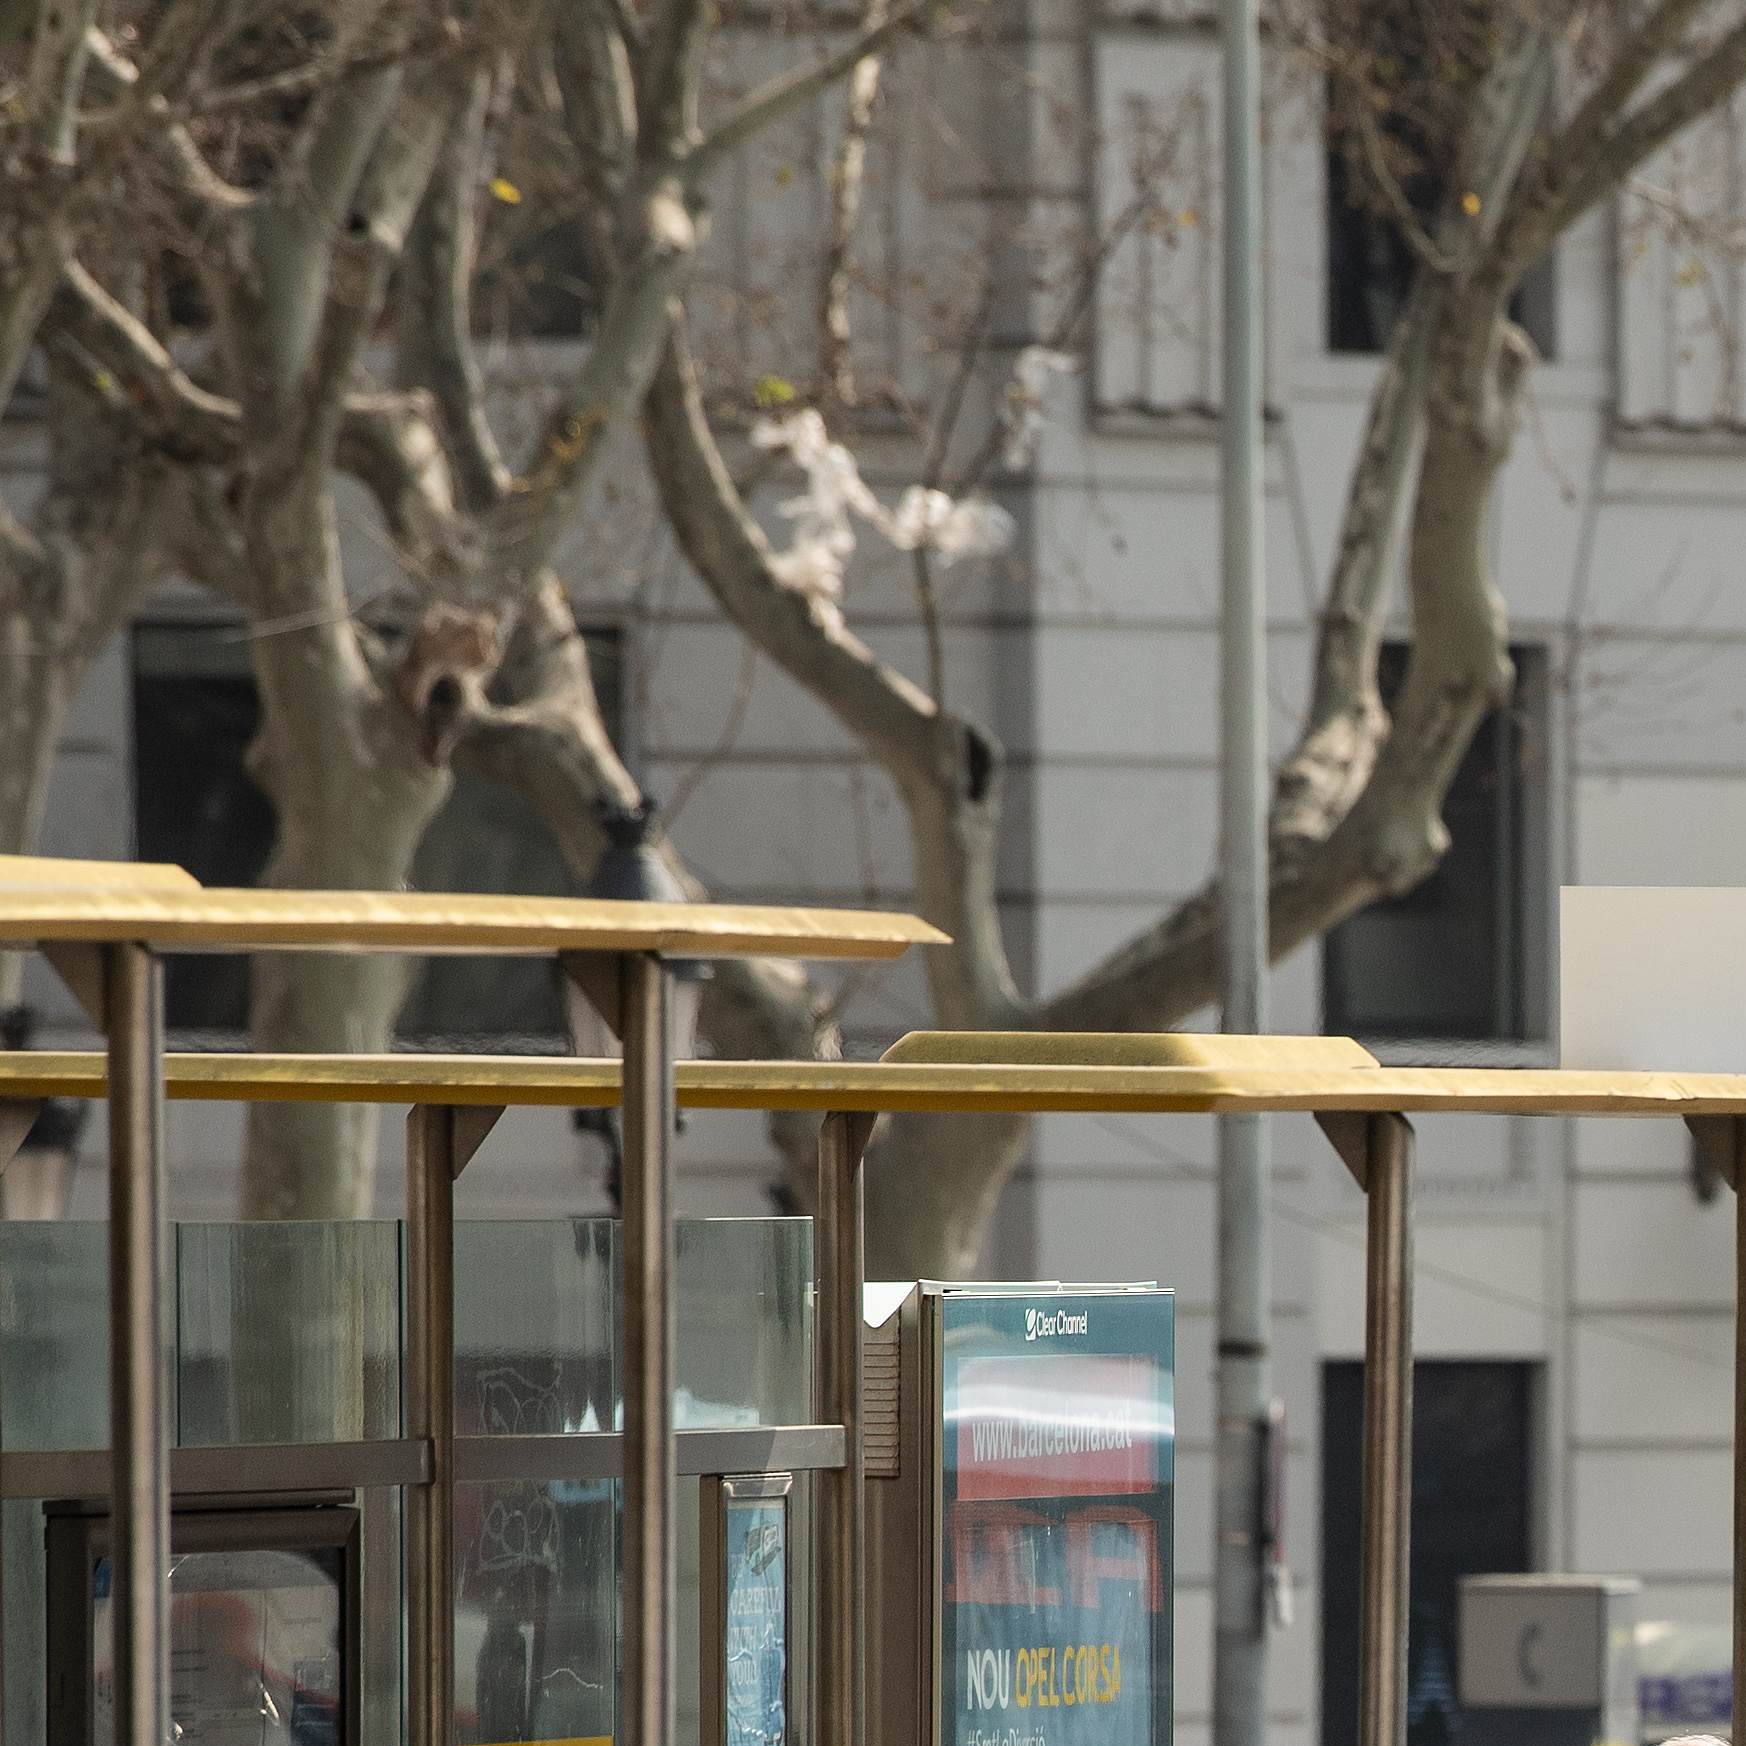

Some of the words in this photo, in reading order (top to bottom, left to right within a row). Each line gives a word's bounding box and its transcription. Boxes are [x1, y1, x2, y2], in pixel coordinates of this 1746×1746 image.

[1036, 1311, 1057, 1337] Clear
[1057, 1309, 1088, 1336] Channel
[972, 1397, 1132, 1463] www.barcelona.cat
[967, 1648, 1011, 1710] NOU
[1015, 1647, 1060, 1708] OPEL
[1062, 1643, 1121, 1706] CORSA
